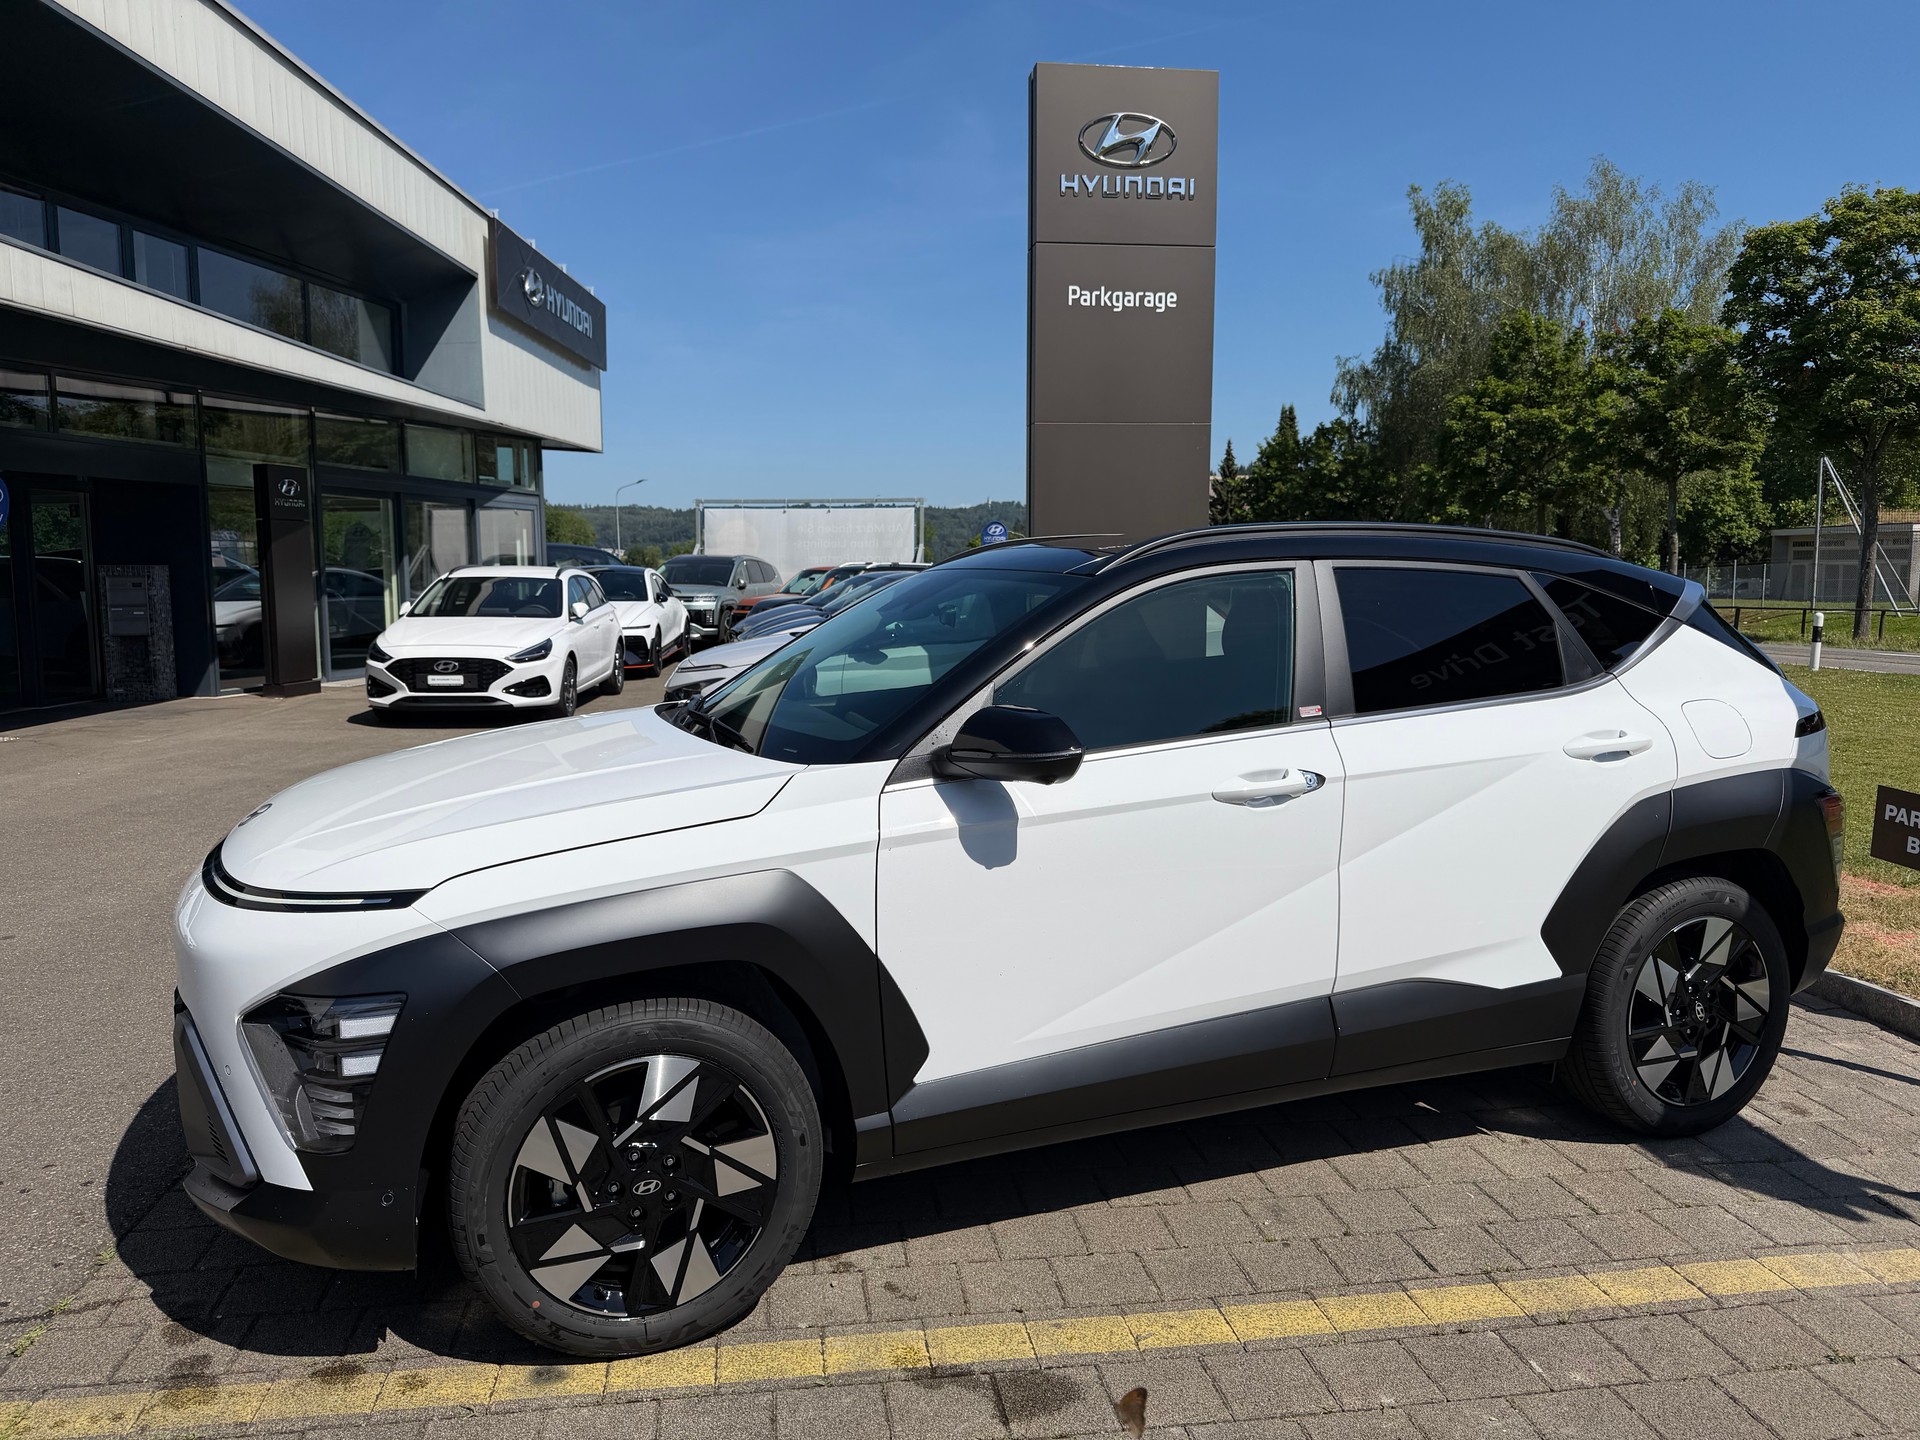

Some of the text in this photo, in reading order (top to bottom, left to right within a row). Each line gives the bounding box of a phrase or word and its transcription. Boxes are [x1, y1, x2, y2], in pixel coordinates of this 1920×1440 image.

[1060, 174, 1195, 200] HYUNDAI
[546, 284, 593, 339] HYUNDAI
[1068, 285, 1178, 312] Parkgarage
[274, 498, 305, 508] HYUNDAI
[1885, 804, 1920, 829] PAR
